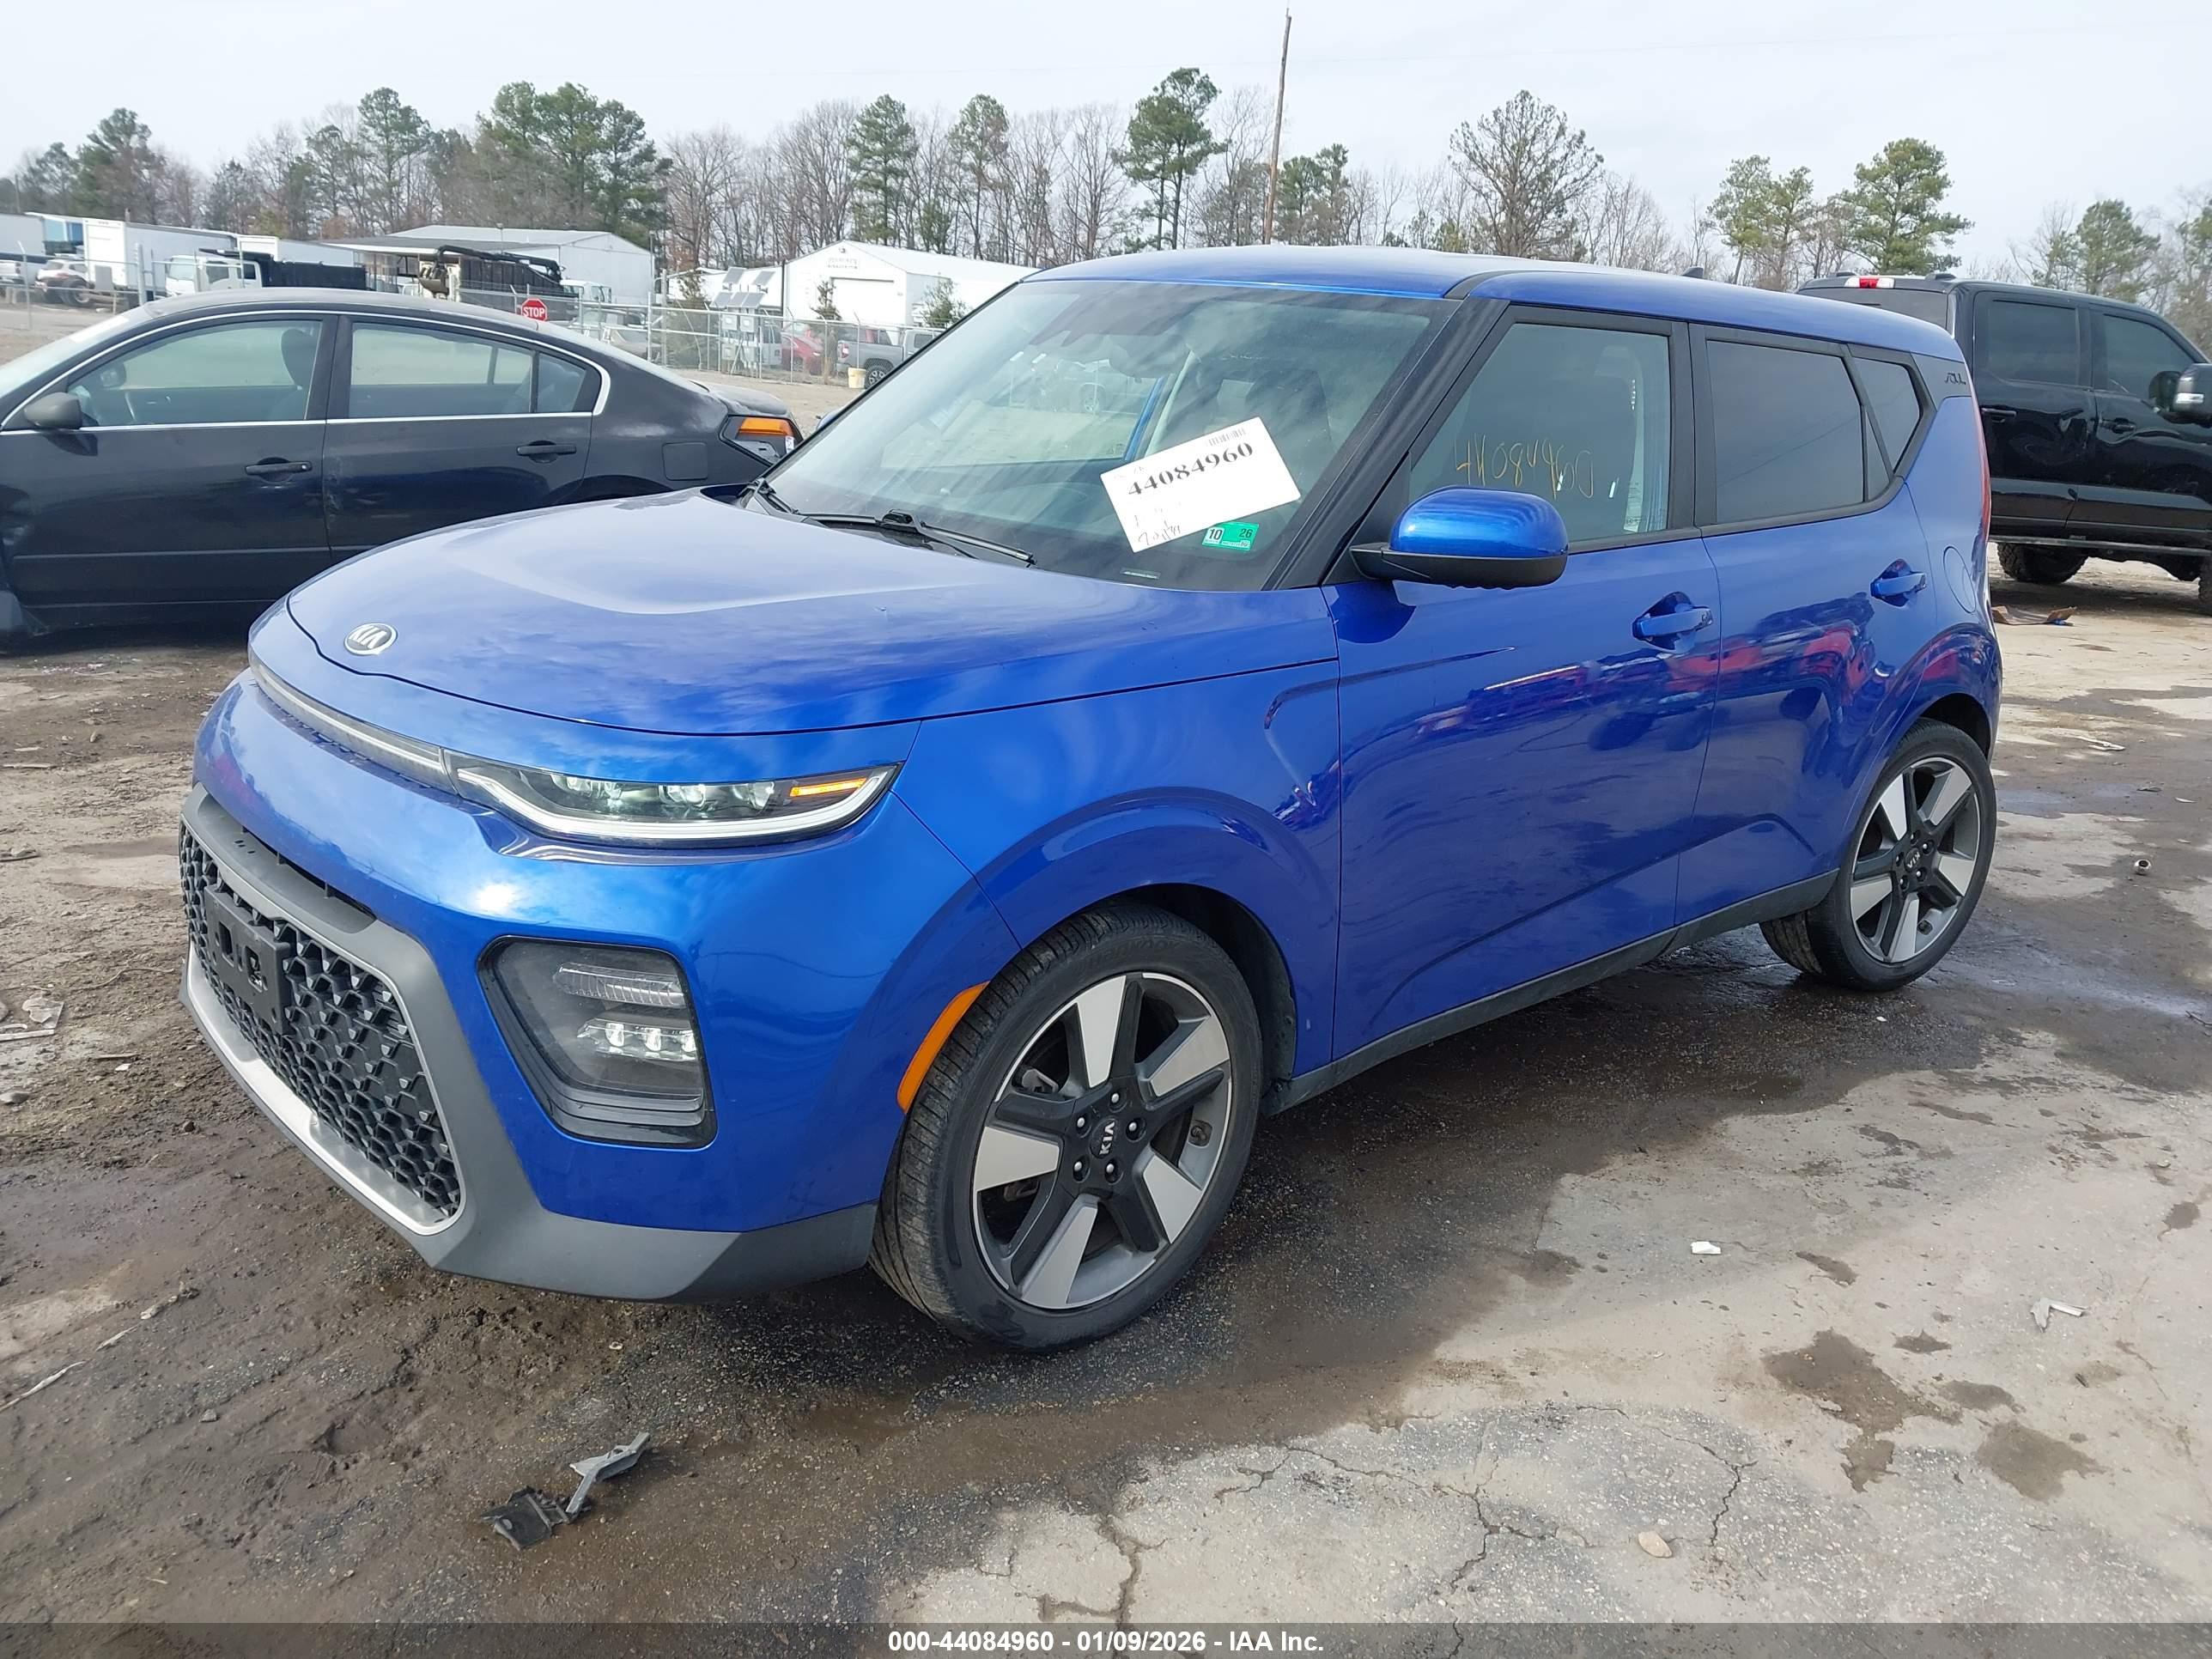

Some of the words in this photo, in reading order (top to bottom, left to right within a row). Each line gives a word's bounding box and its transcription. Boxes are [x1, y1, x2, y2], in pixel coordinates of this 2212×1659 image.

[523, 307, 545, 318] STOP
[1127, 442, 1254, 495] 44084960
[1208, 528, 1223, 540] 10
[1238, 528, 1254, 538] 26
[1906, 851, 1920, 868] KIA
[1099, 1121, 1115, 1155] KIA
